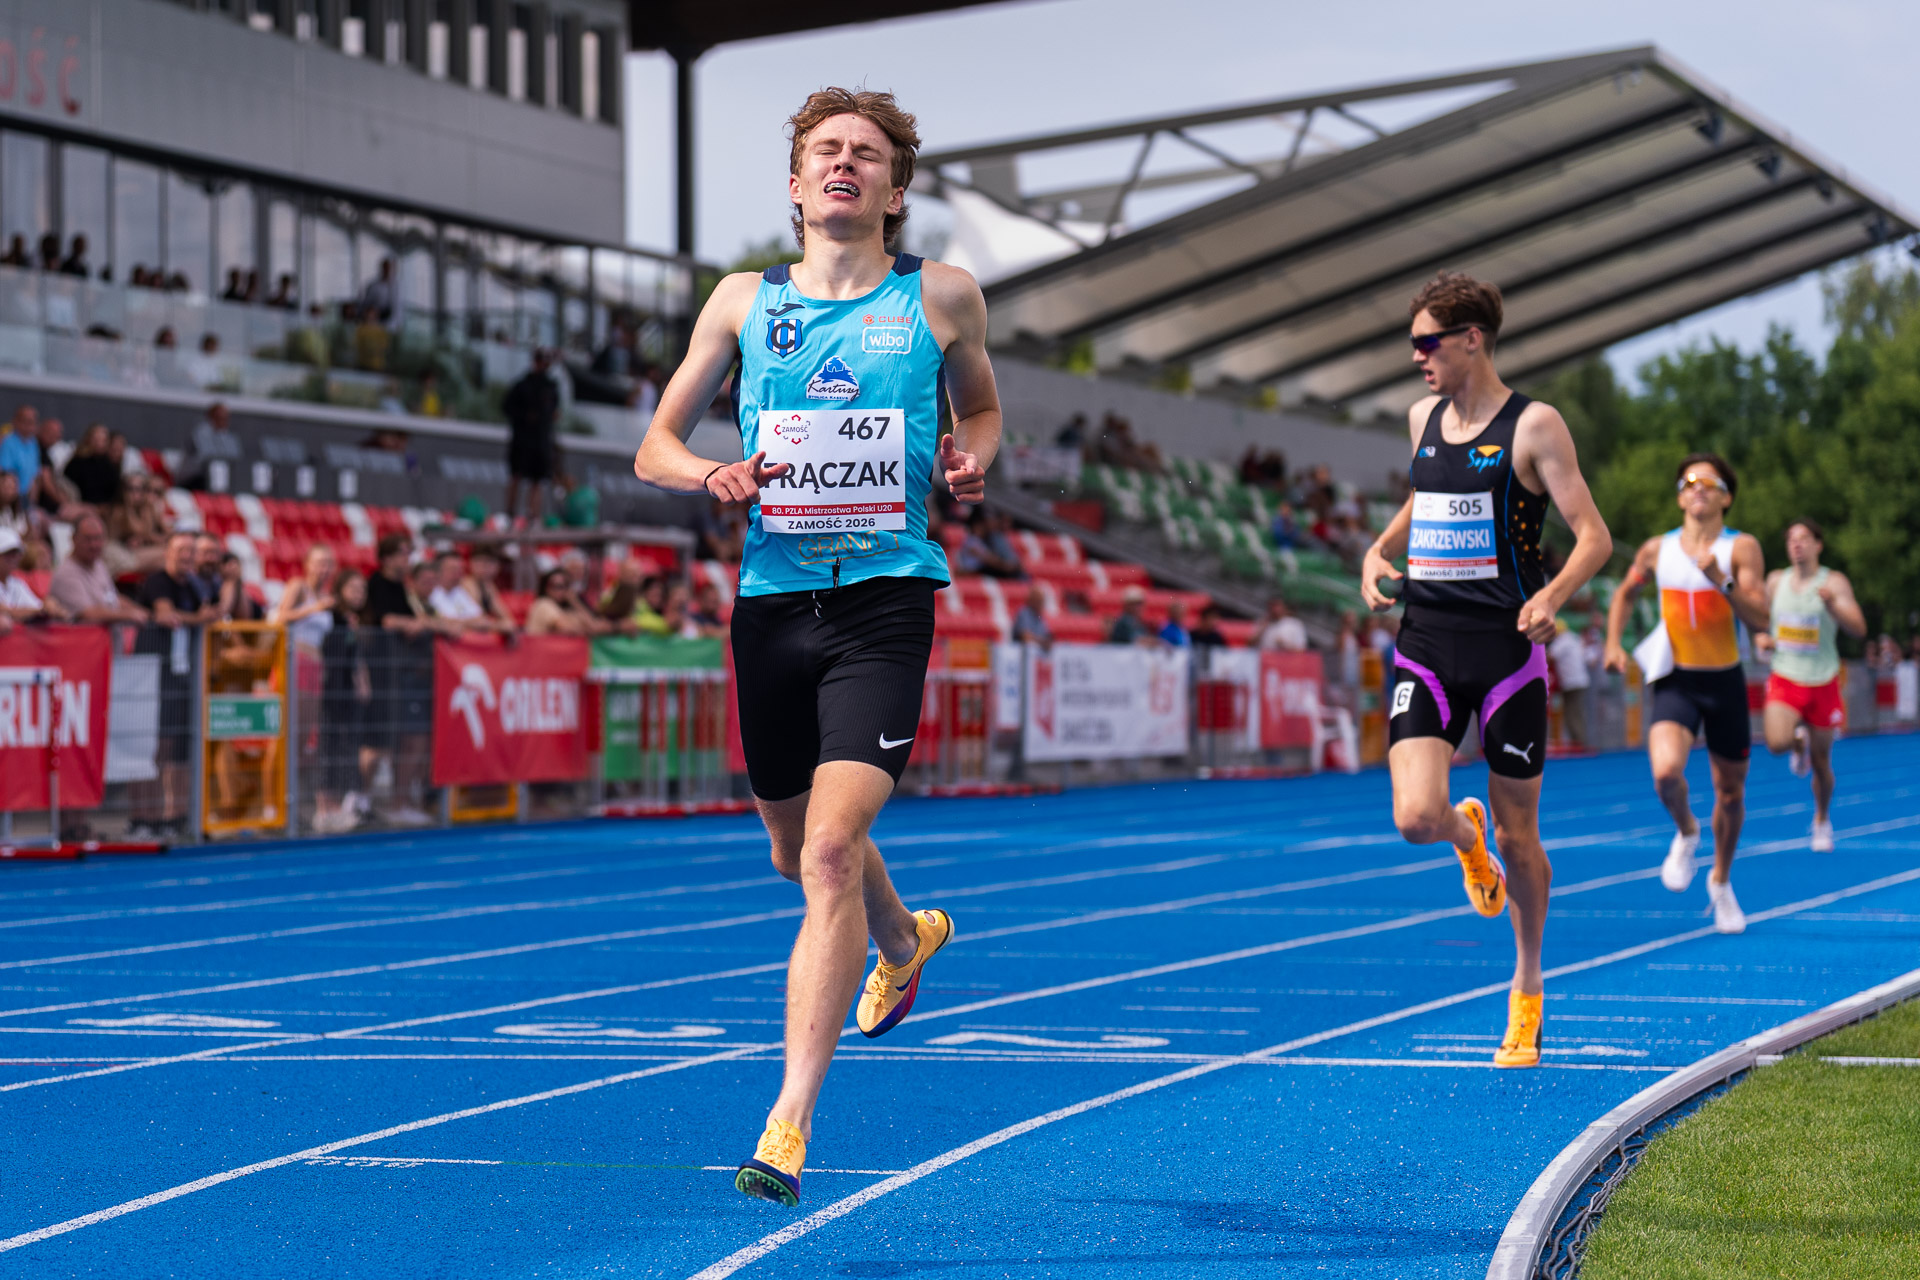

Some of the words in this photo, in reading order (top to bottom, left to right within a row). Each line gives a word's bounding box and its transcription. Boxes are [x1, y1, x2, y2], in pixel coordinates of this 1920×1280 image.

[878, 316, 913, 325] CUBE
[869, 331, 905, 347] wibo
[781, 425, 808, 433] ZAMOŚĆ
[838, 416, 891, 441] 467
[772, 507, 784, 515] 80.
[785, 507, 803, 515] PZLA
[804, 504, 852, 515] Mistrzostwa
[853, 504, 876, 513] Polski
[877, 504, 893, 512] U20
[1448, 499, 1483, 516] 505
[787, 517, 843, 530] ZAMOŚĆ
[845, 518, 876, 528] 2026
[1411, 527, 1490, 550] ZAKRZEWSKI
[1397, 688, 1410, 707] 6
